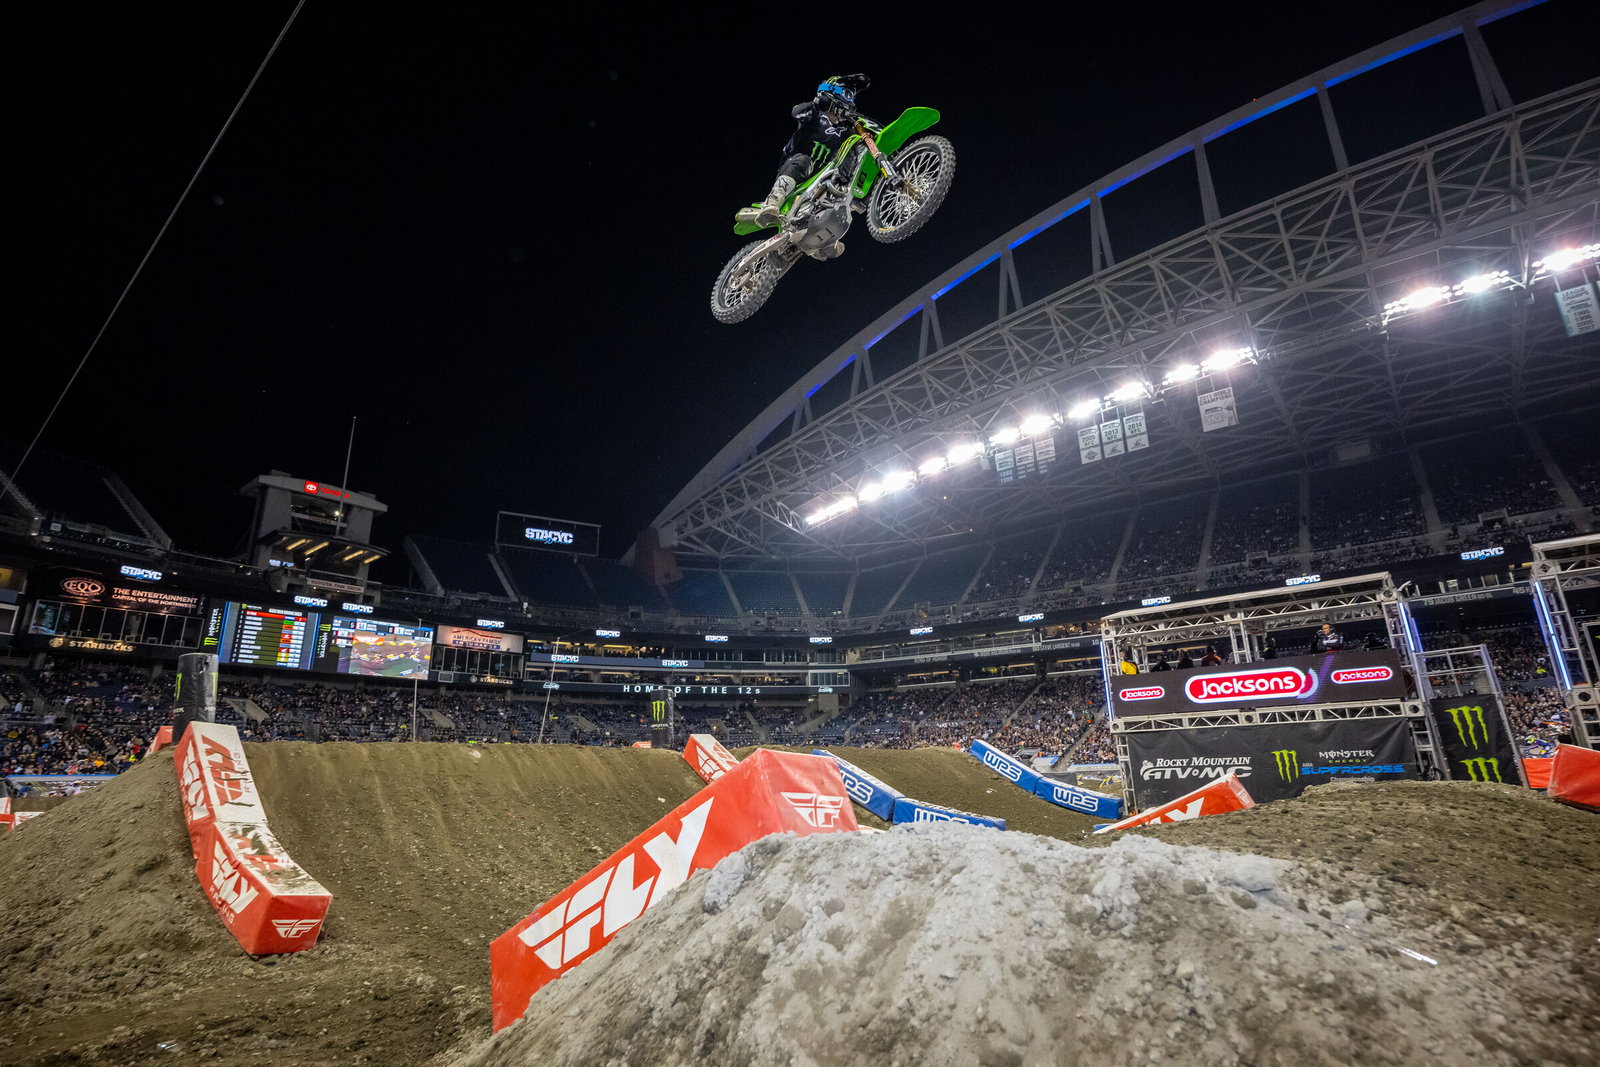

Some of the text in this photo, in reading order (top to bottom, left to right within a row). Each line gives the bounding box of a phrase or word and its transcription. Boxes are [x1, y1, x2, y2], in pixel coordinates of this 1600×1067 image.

[1128, 422, 1143, 430] 2014
[1104, 428, 1119, 437] 2013
[526, 528, 573, 544] STACYC
[1460, 546, 1505, 560] STACYC
[120, 565, 163, 581] STACYC
[1286, 574, 1321, 586] STACYC
[112, 594, 137, 602] CAPITAL
[113, 587, 131, 595] THE
[131, 589, 198, 604] ENTERTAINMENT
[294, 595, 328, 607] STACYC
[1142, 596, 1171, 606] STACYC
[342, 602, 374, 614] STACYC
[1019, 613, 1045, 622] STACYC
[477, 619, 505, 629] STACYC
[596, 629, 621, 637] STACYC
[910, 627, 933, 635] STACYC
[453, 634, 482, 642] AMERICAN
[69, 639, 134, 652] STARBUCKS
[551, 654, 579, 662] STACYC
[662, 659, 688, 667] STACYC
[480, 676, 513, 685] STARBUCKS
[1339, 669, 1387, 682] Jacksons
[702, 686, 727, 694] THE
[1198, 675, 1295, 699] Jacksons
[1125, 689, 1161, 699] Jacksons
[1318, 750, 1375, 759] MONSTER
[983, 750, 1023, 782] WPS
[1156, 756, 1252, 767] ROCKY MOUNTAIN
[1301, 765, 1405, 775] SUPERCROSS
[840, 770, 874, 805] PS
[1053, 786, 1099, 812] WPS
[212, 840, 260, 915] FLY
[518, 796, 714, 970] FLY
